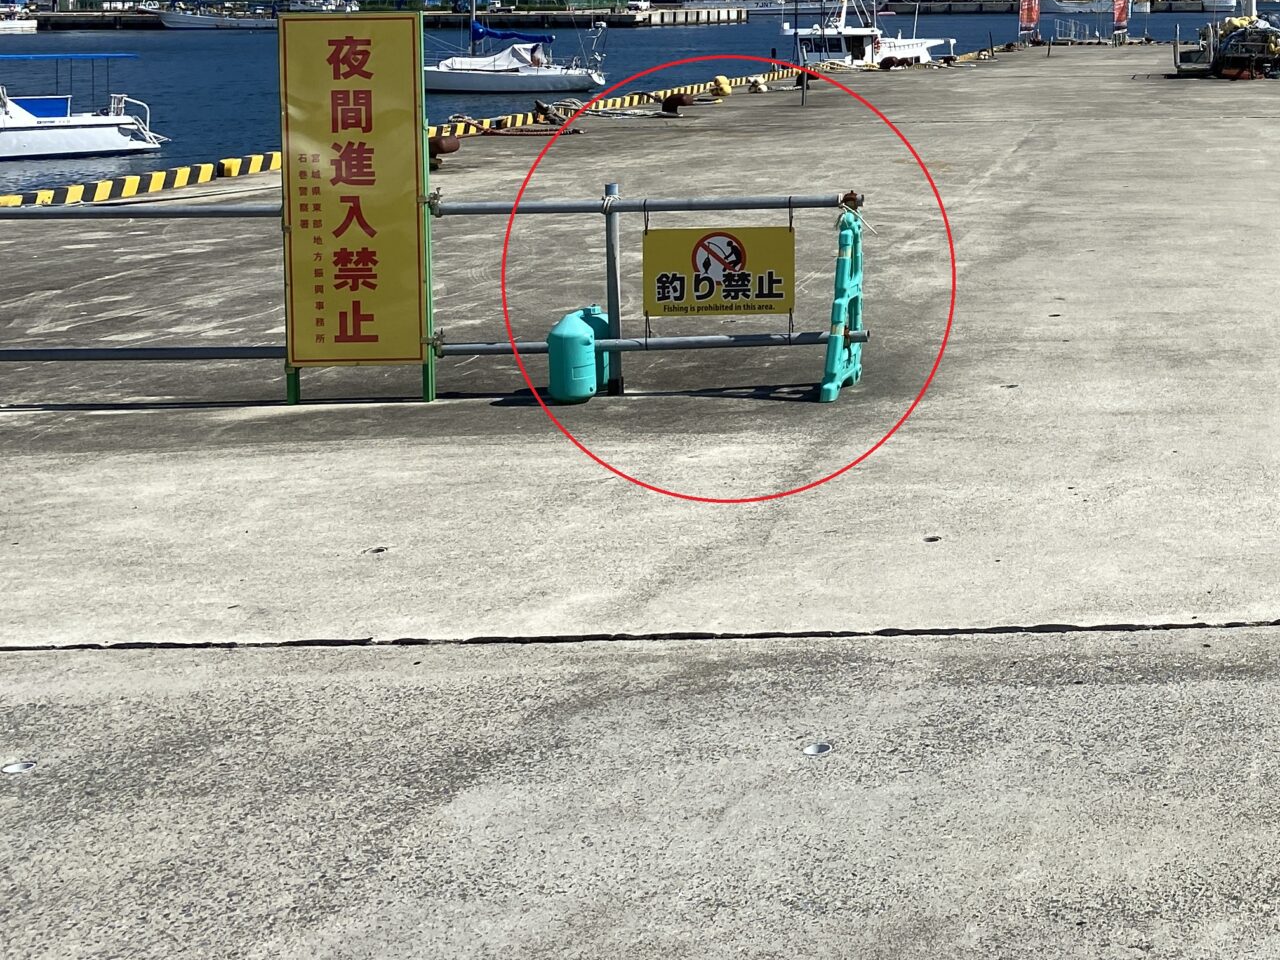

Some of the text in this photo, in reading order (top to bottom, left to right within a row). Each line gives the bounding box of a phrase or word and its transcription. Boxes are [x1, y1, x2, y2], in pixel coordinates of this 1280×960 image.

[326, 35, 379, 344] 夜間進入禁止
[656, 271, 784, 302] 釣り禁止
[663, 305, 689, 313] Fishing
[697, 304, 733, 312] prohibited
